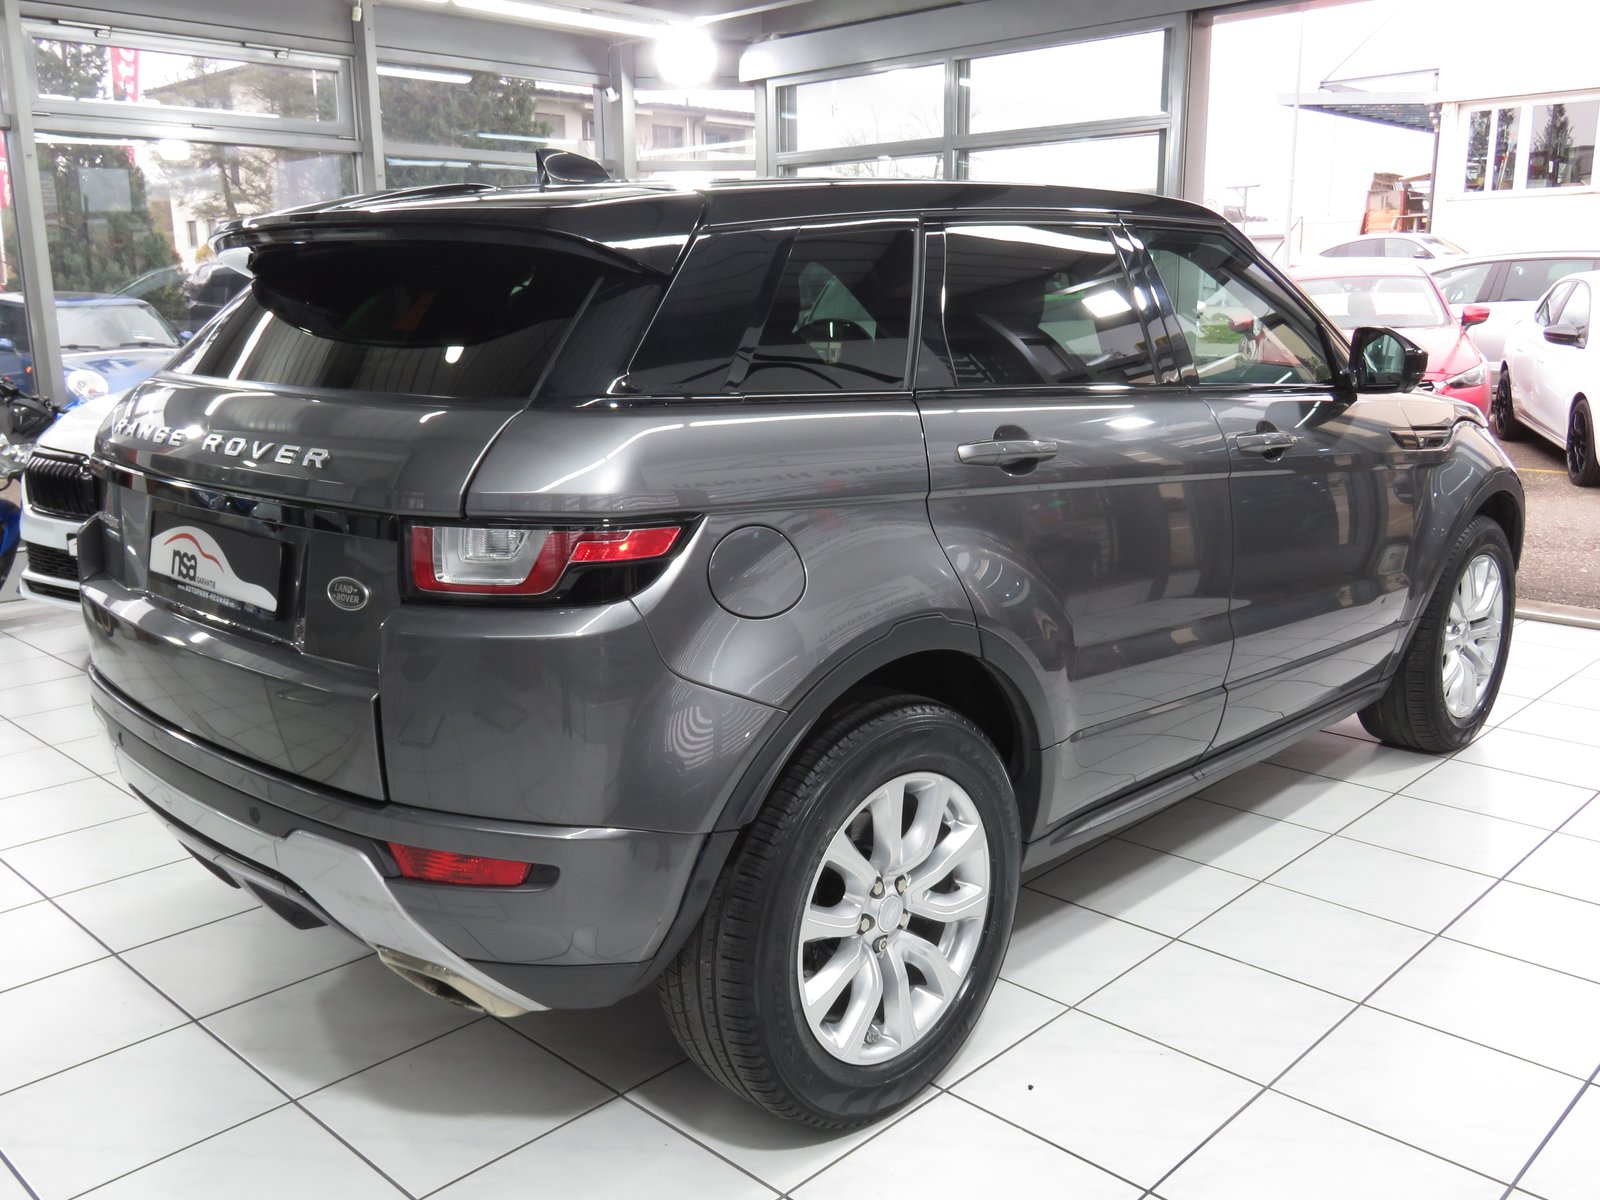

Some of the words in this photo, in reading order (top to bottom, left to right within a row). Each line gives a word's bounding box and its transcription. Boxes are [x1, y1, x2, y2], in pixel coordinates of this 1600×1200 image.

[113, 418, 186, 447] RANGE
[201, 433, 332, 470] ROVER
[171, 548, 197, 583] nsa
[196, 576, 217, 589] GARANTIE
